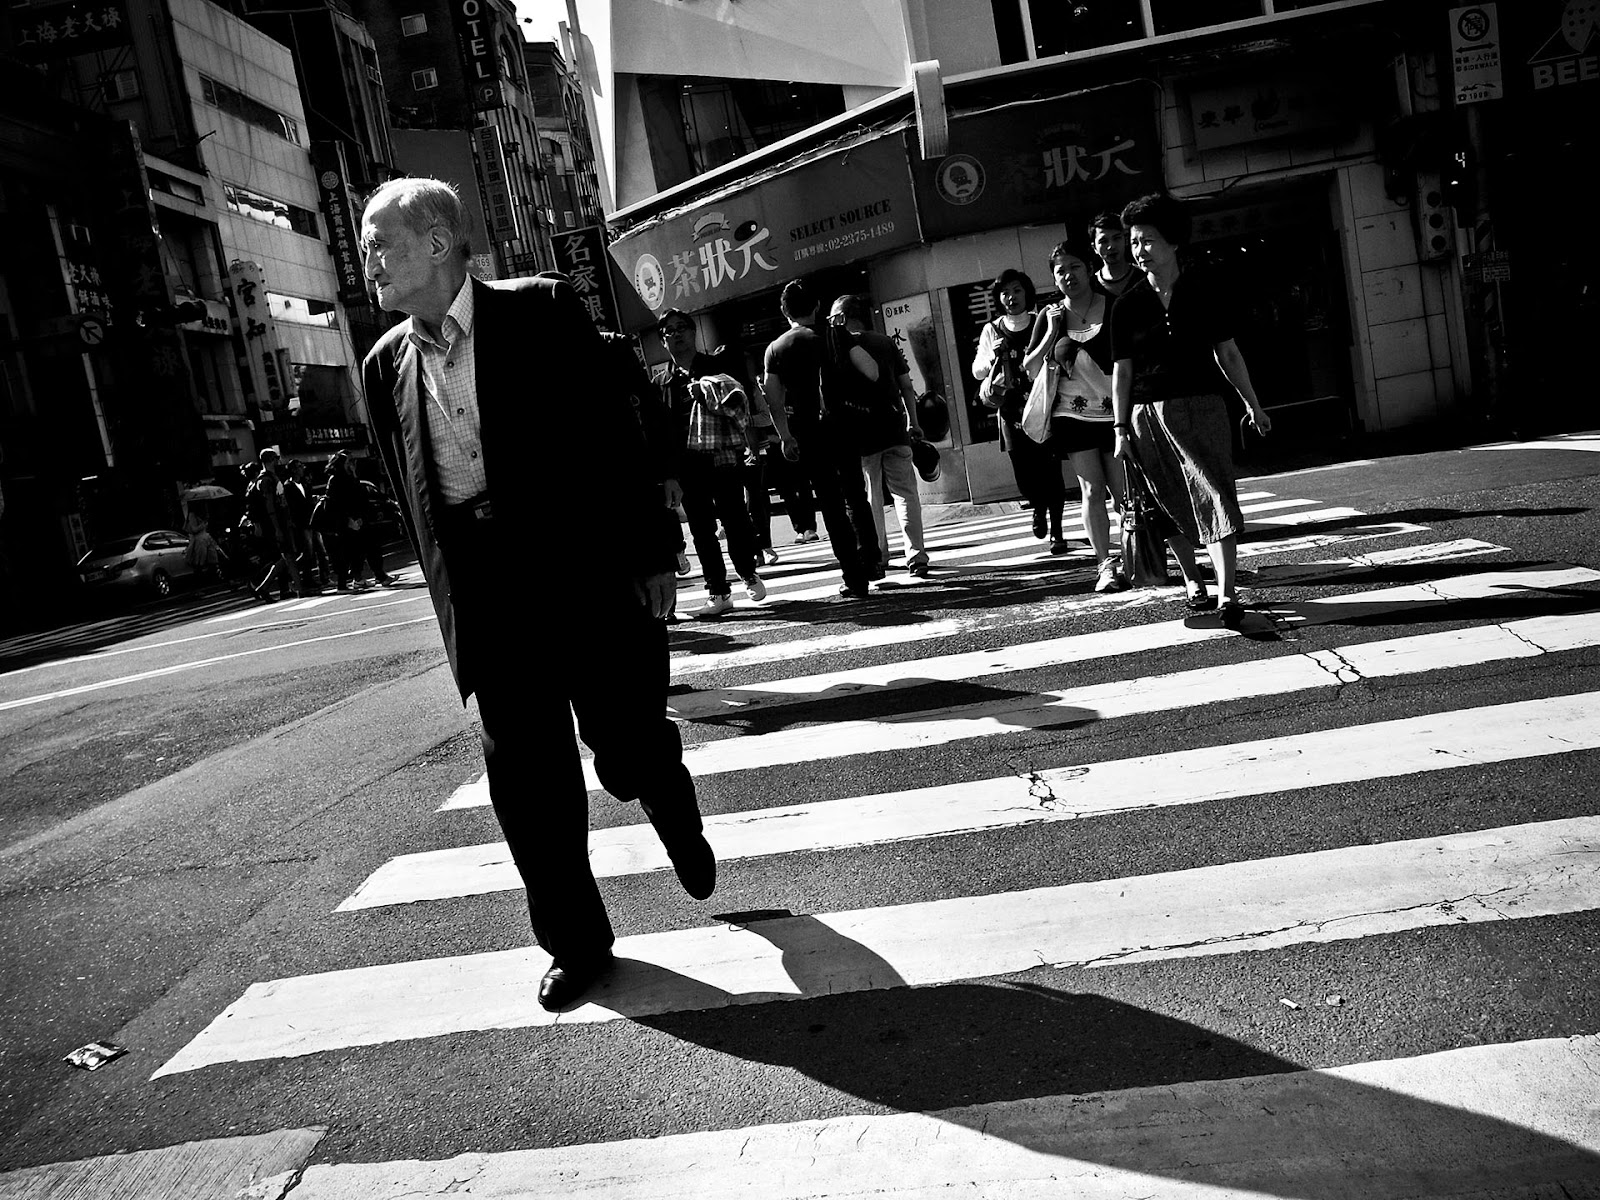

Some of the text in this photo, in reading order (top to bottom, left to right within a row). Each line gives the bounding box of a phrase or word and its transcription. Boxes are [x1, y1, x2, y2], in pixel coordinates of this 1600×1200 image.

[1455, 152, 1465, 168] 4
[790, 199, 891, 242] SELECT SOURCE
[564, 235, 609, 332] 名家銀
